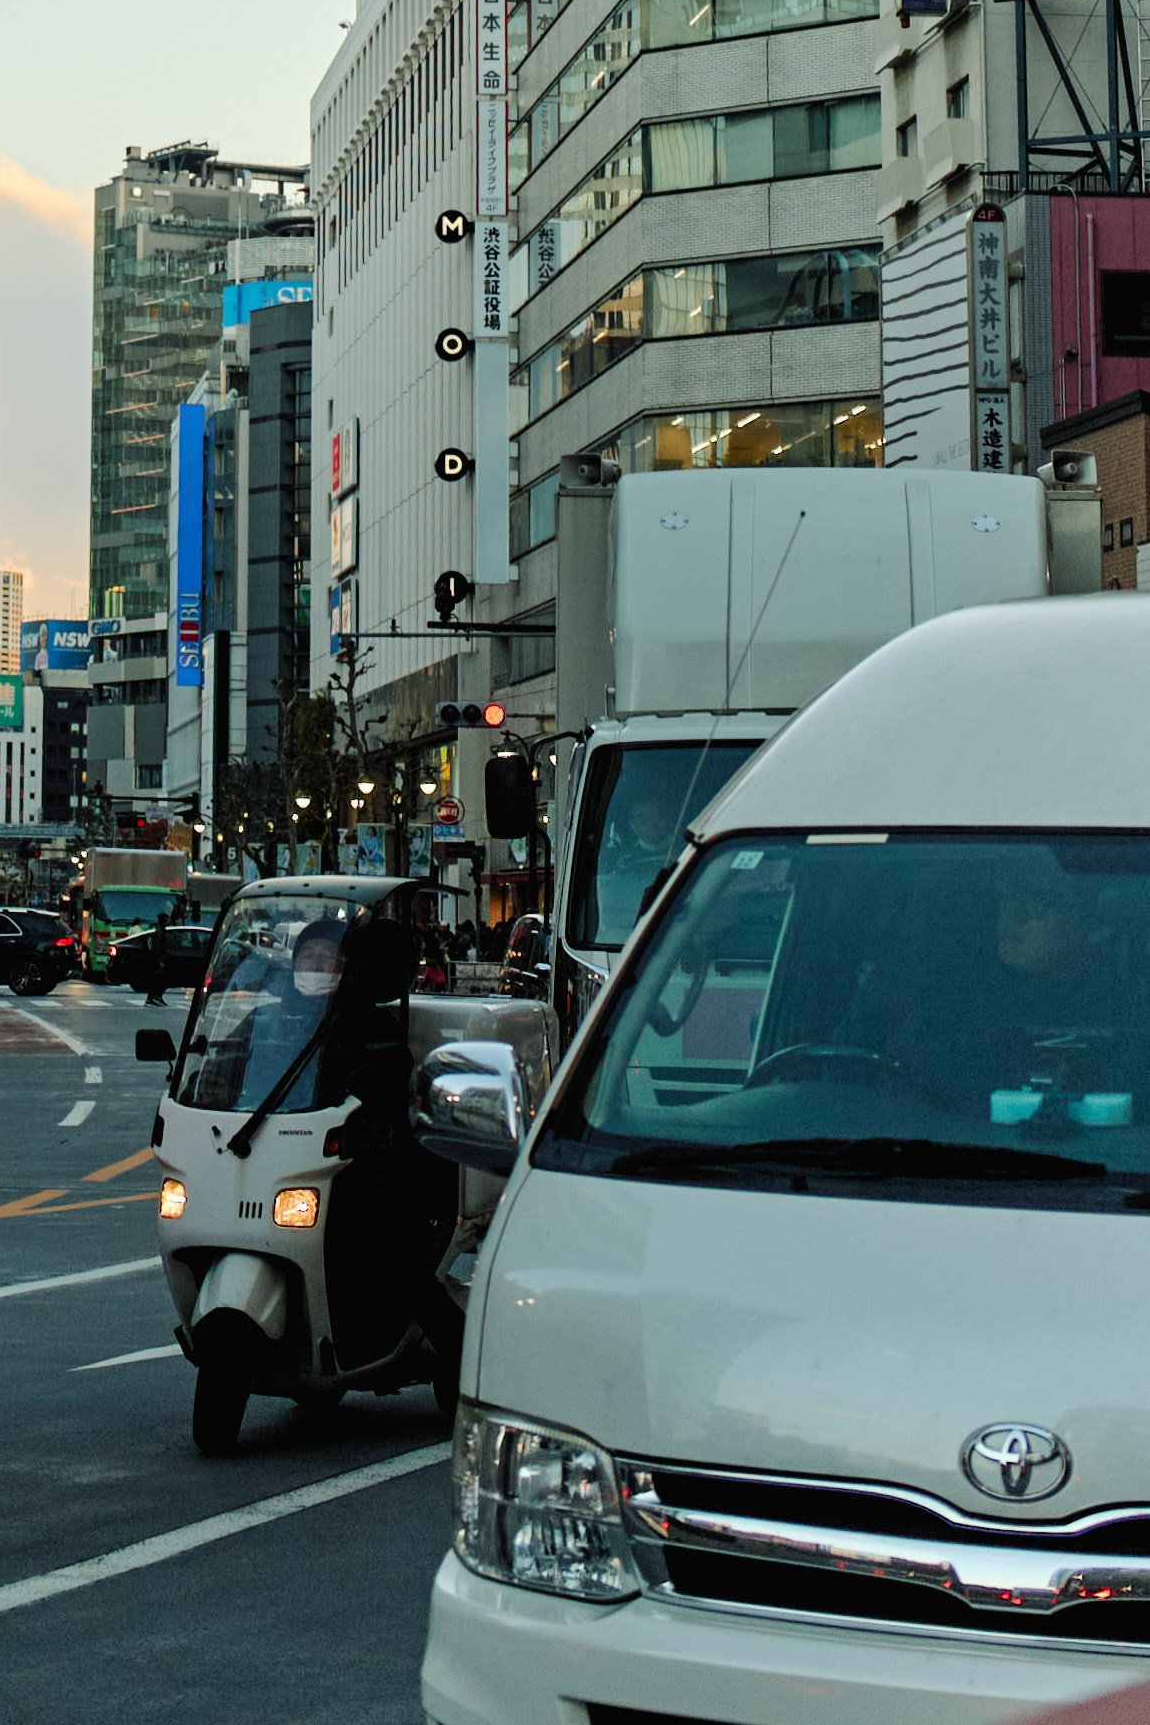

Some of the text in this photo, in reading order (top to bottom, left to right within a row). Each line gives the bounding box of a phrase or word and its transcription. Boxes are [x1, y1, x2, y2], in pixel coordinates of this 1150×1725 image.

[486, 104, 497, 196] ニッセイライフプラザ
[977, 210, 997, 221] 4F
[483, 226, 502, 332] 渋谷公証役場
[977, 232, 1002, 379] 神南大井ビル
[982, 407, 1004, 473] 木造建
[53, 631, 91, 648] NSW
[179, 593, 200, 668] SEIBU
